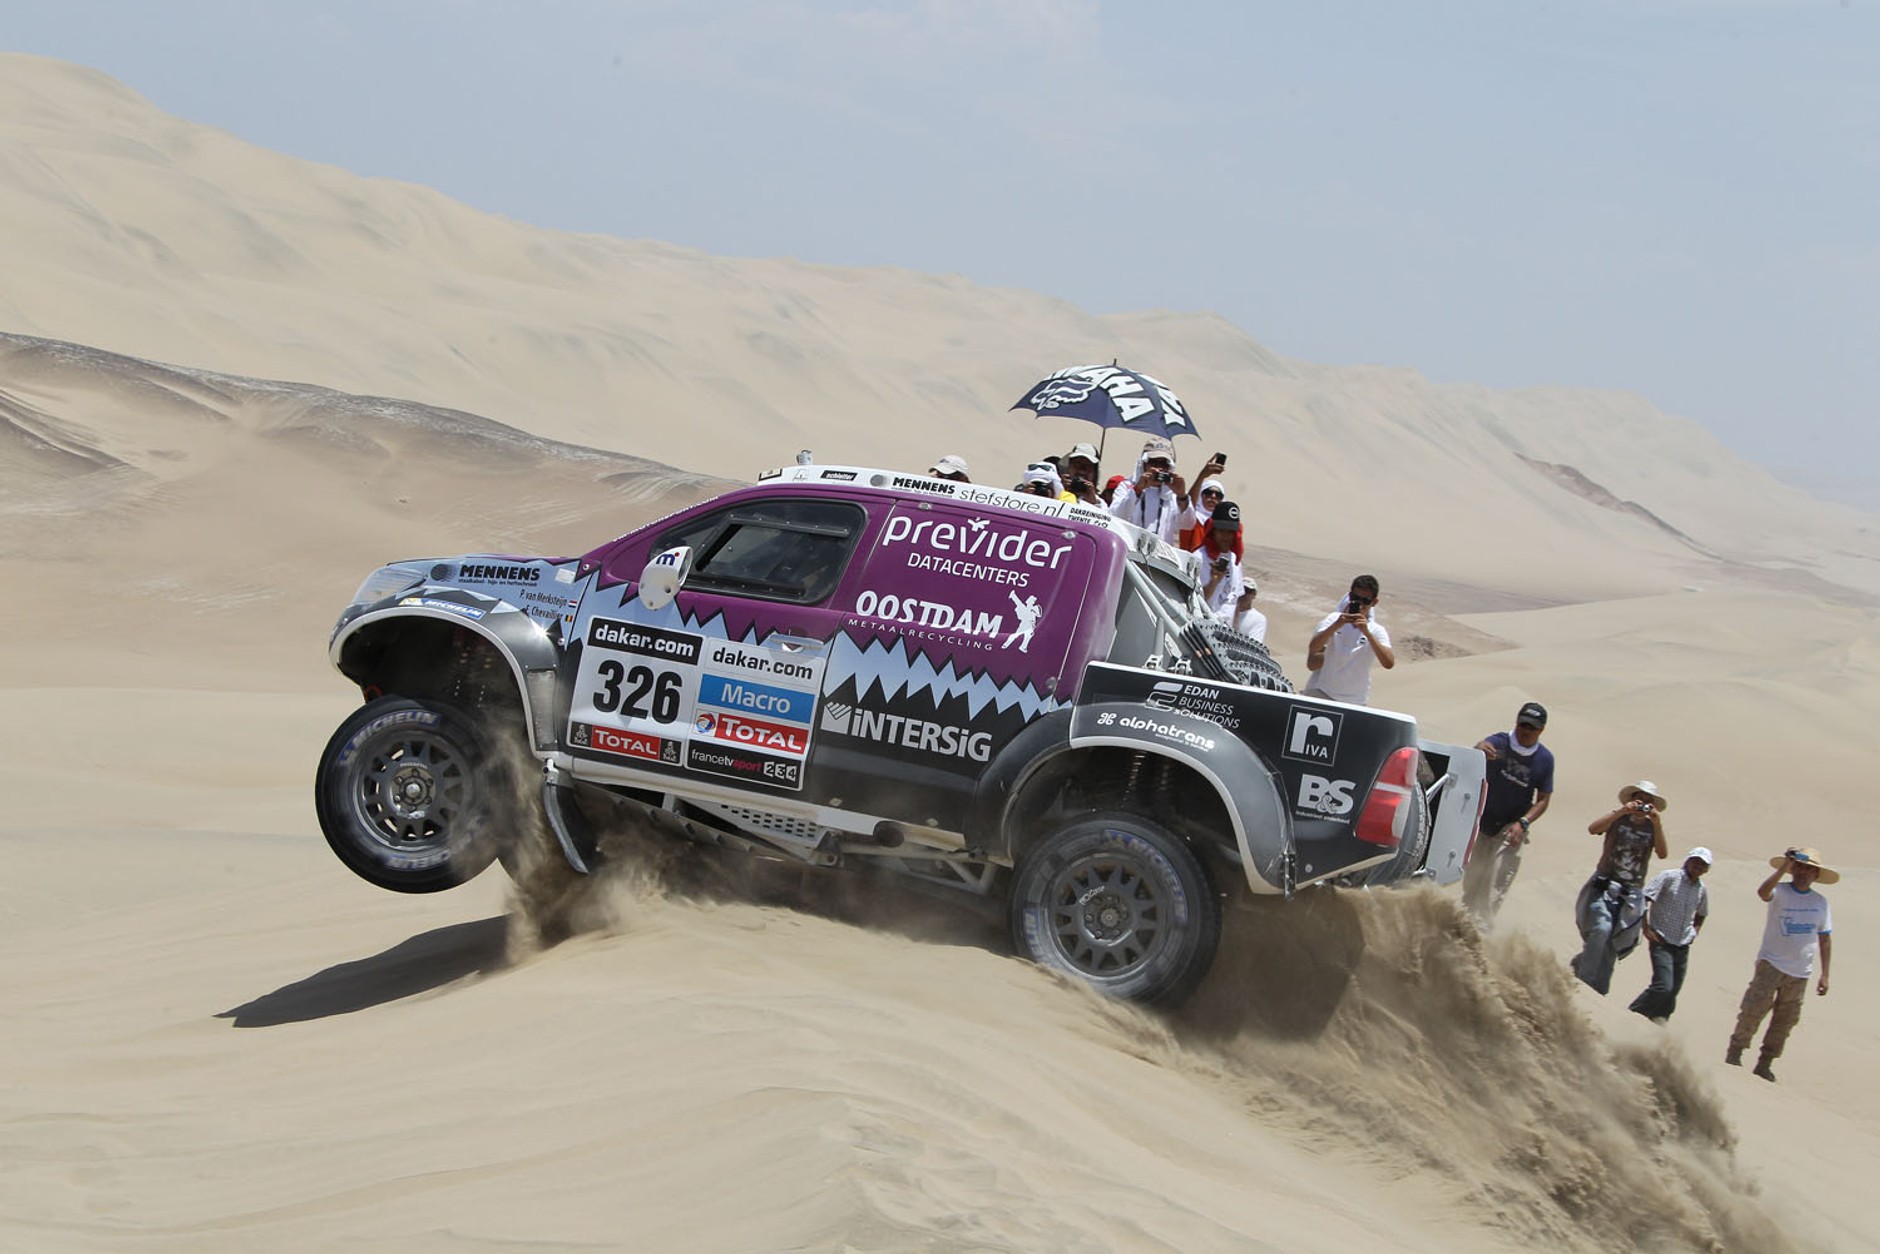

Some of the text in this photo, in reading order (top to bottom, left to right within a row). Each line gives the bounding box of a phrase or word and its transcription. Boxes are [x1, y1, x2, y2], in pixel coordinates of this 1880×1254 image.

[892, 477, 956, 495] MENNENS
[959, 488, 1066, 518] stefstore.nl
[882, 516, 1073, 570] previder
[460, 564, 541, 581] MENNENS
[907, 553, 1030, 588] DATACENTERS
[424, 600, 482, 618] MICHELIN
[526, 592, 536, 602] van
[855, 590, 1004, 639] OOSTDAM
[595, 625, 694, 657] dakar.com
[848, 619, 993, 651] METAALRECYCLING
[713, 648, 813, 679] dakar.com
[593, 660, 682, 725] 326
[721, 684, 791, 714] Macro
[1179, 697, 1234, 715] BUSINESS
[1184, 684, 1220, 699] EDAN
[352, 711, 439, 749] MICHELIN
[1120, 716, 1215, 750] alphatrans
[1174, 707, 1241, 728] SOLUTIONS
[595, 730, 657, 755] TOTAL
[723, 718, 801, 750] TOTAL
[1297, 773, 1356, 815] B&S
